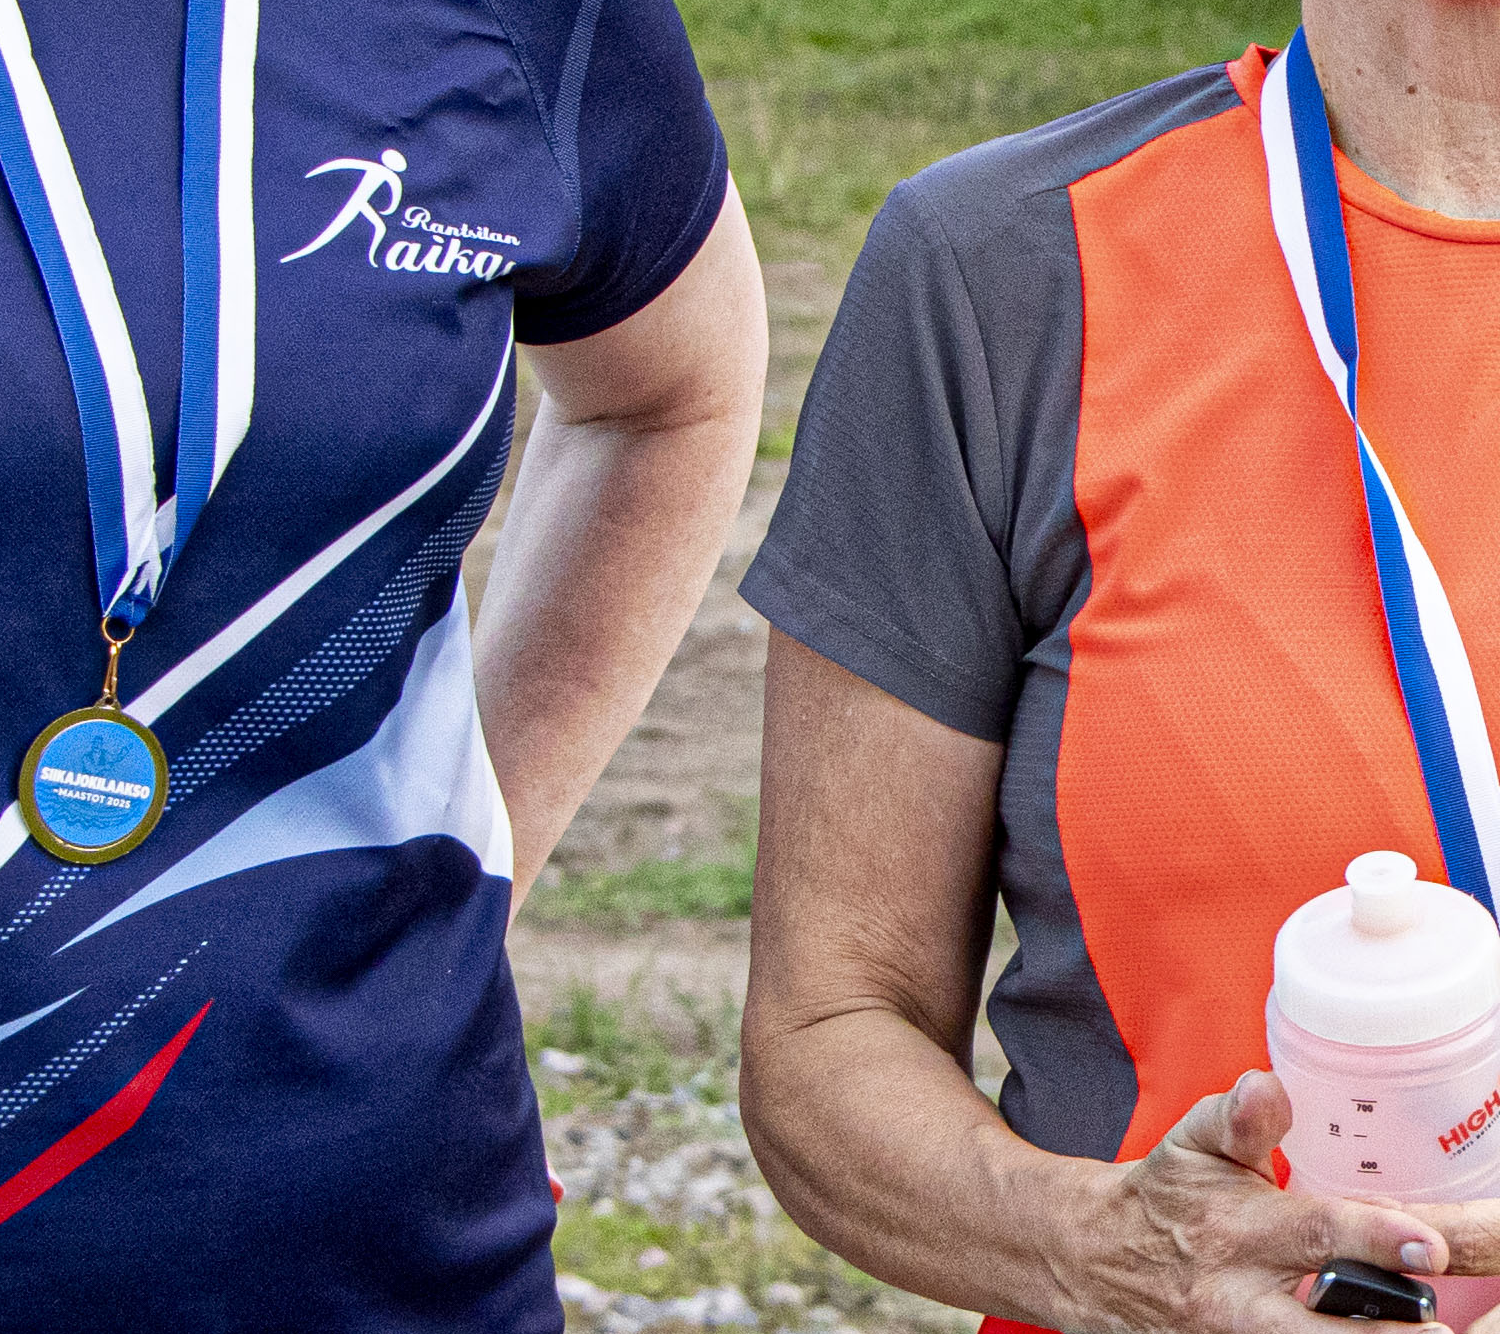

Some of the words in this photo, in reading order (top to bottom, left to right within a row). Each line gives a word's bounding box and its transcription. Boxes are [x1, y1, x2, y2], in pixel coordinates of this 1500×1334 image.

[401, 206, 521, 246] Rantsilan
[107, 794, 132, 809] 2025
[1356, 1103, 1374, 1113] 700
[1361, 1160, 1378, 1170] 600
